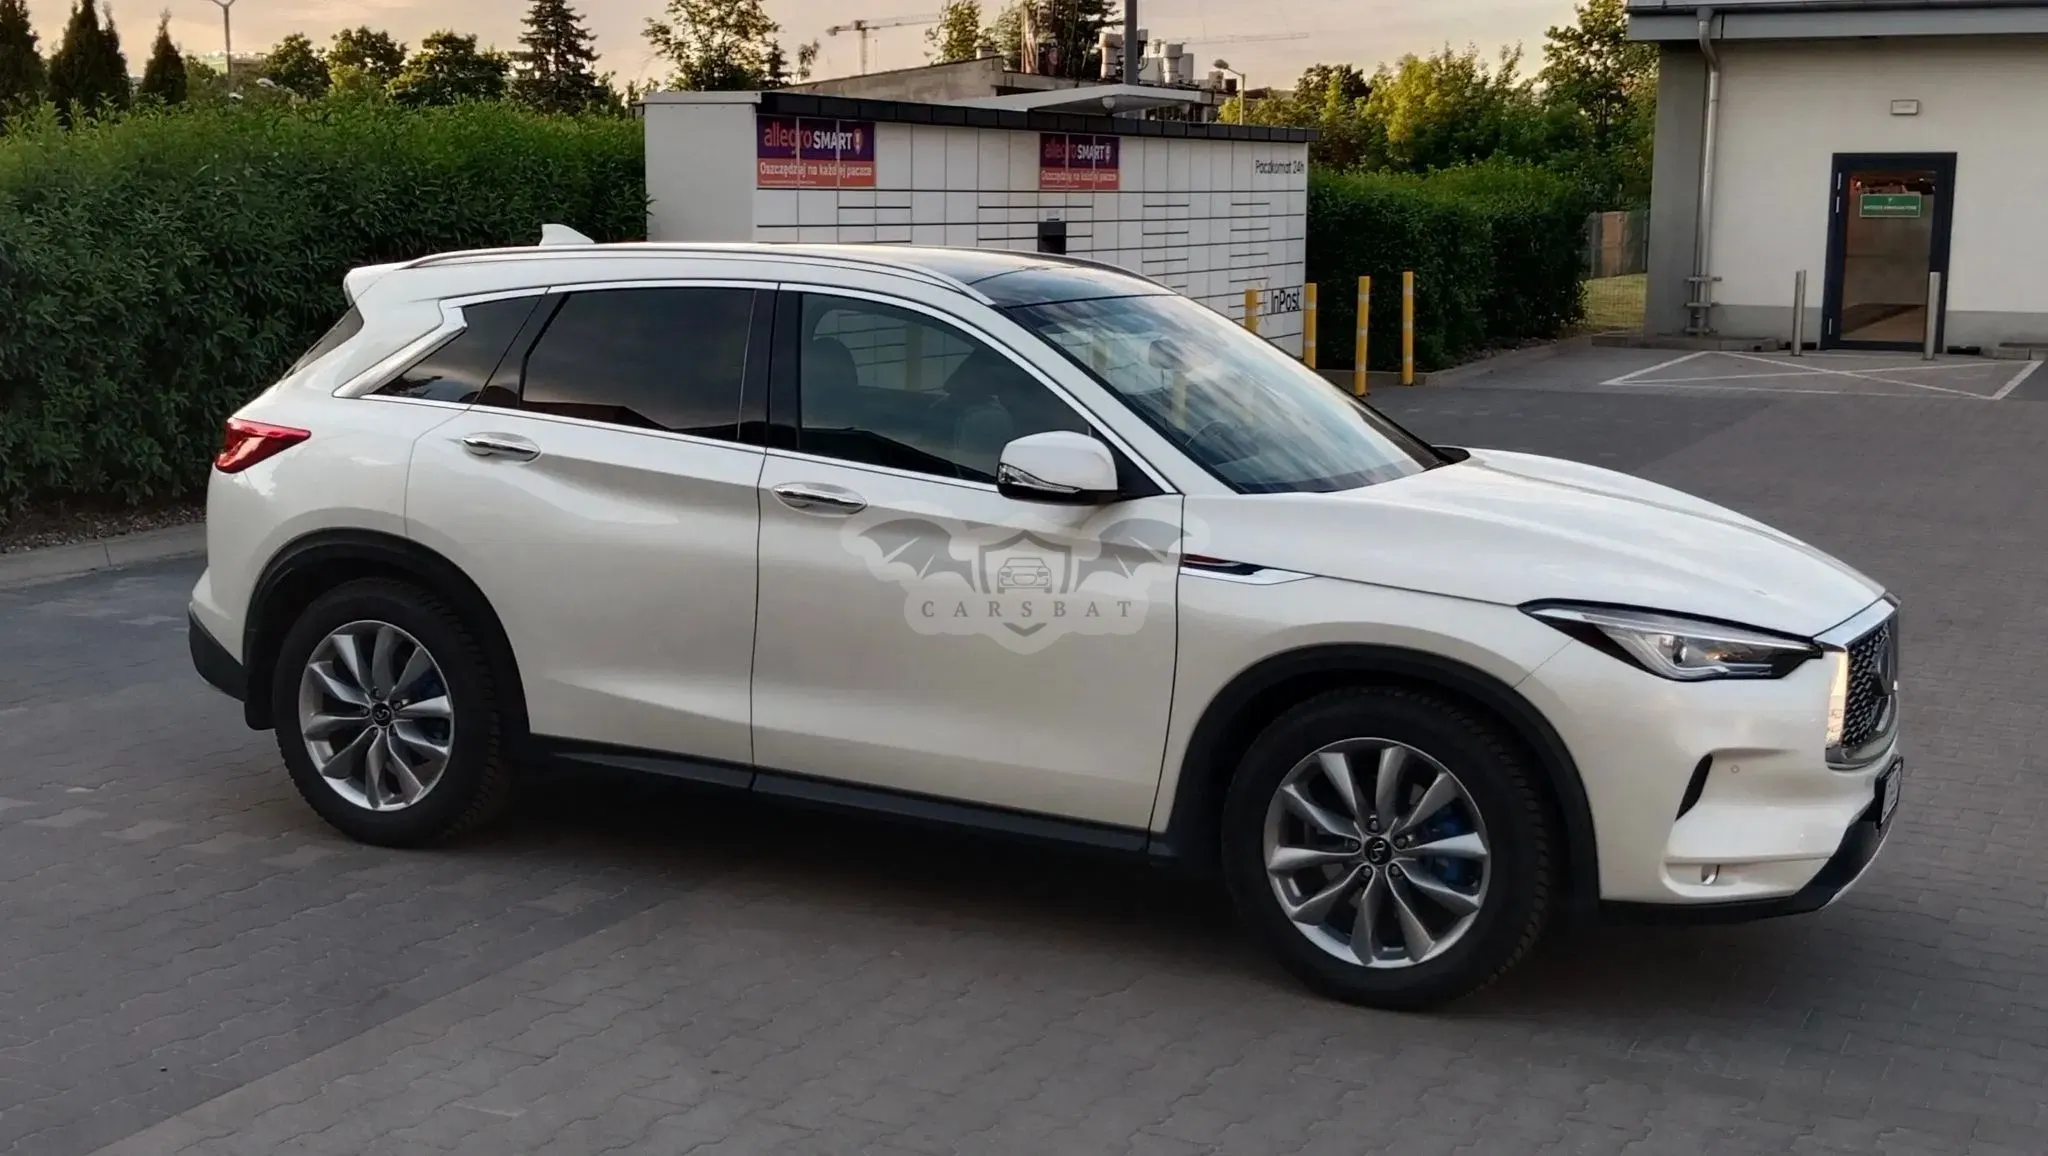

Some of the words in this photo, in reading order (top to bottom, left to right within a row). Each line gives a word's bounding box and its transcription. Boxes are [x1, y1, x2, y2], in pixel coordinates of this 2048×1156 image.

[763, 120, 812, 156] allegro
[808, 166, 817, 176] na
[1271, 288, 1300, 314] InPost
